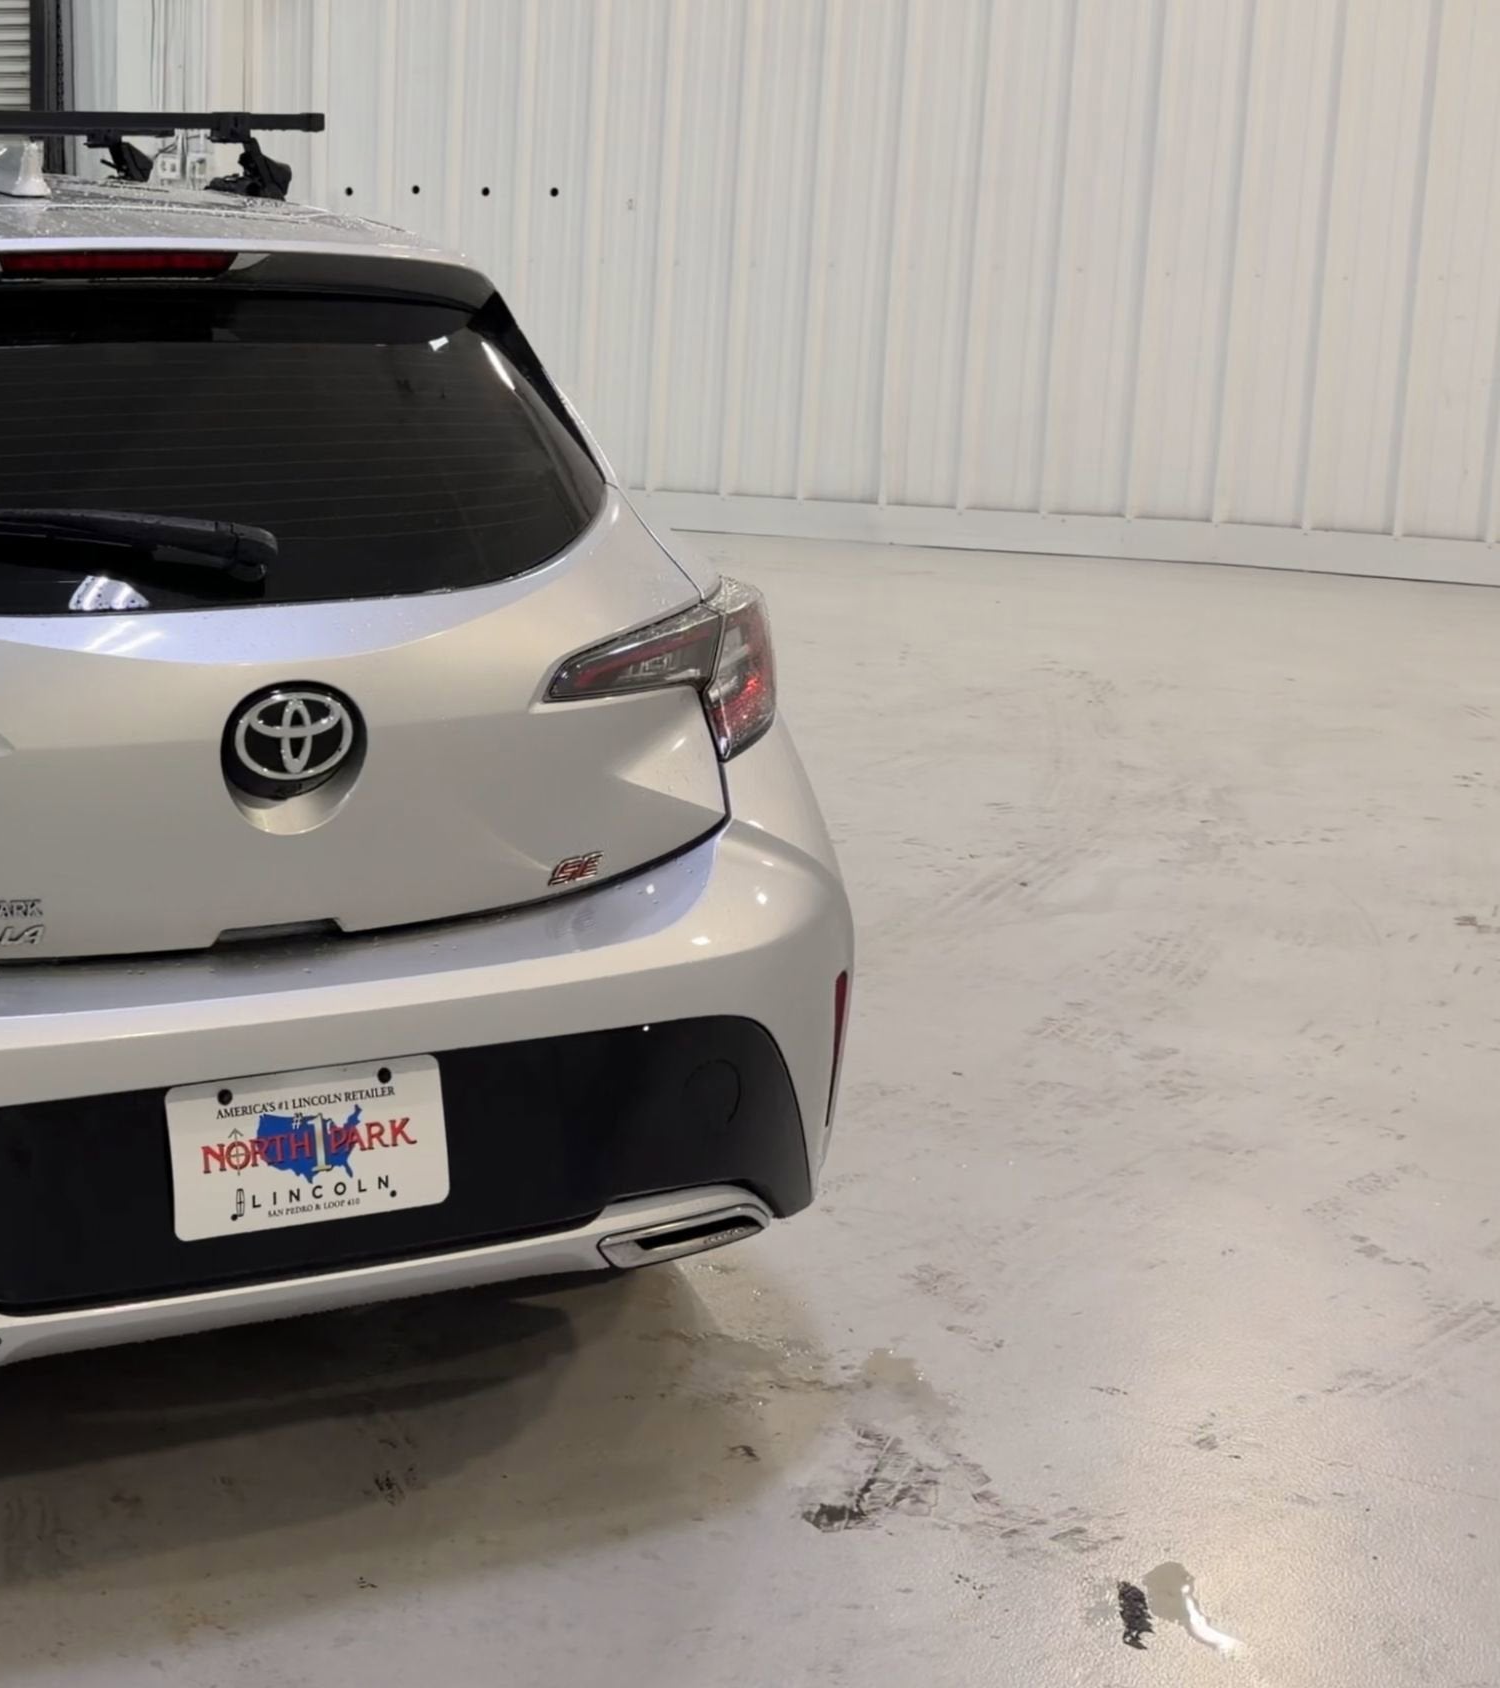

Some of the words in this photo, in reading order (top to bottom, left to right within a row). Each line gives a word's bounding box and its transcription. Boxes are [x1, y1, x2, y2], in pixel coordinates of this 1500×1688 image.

[548, 850, 604, 887] SE
[216, 1100, 277, 1120] AMERICA'S
[277, 1100, 290, 1111] #1
[291, 1092, 343, 1110] LINCOLN
[344, 1085, 396, 1102] RETAILER
[201, 1130, 313, 1175] NORTH
[329, 1117, 418, 1154] PARK
[251, 1175, 390, 1209] LINCOLN
[267, 1208, 284, 1218] SAN
[285, 1204, 313, 1216] PEDRO
[323, 1199, 345, 1210] LOOP
